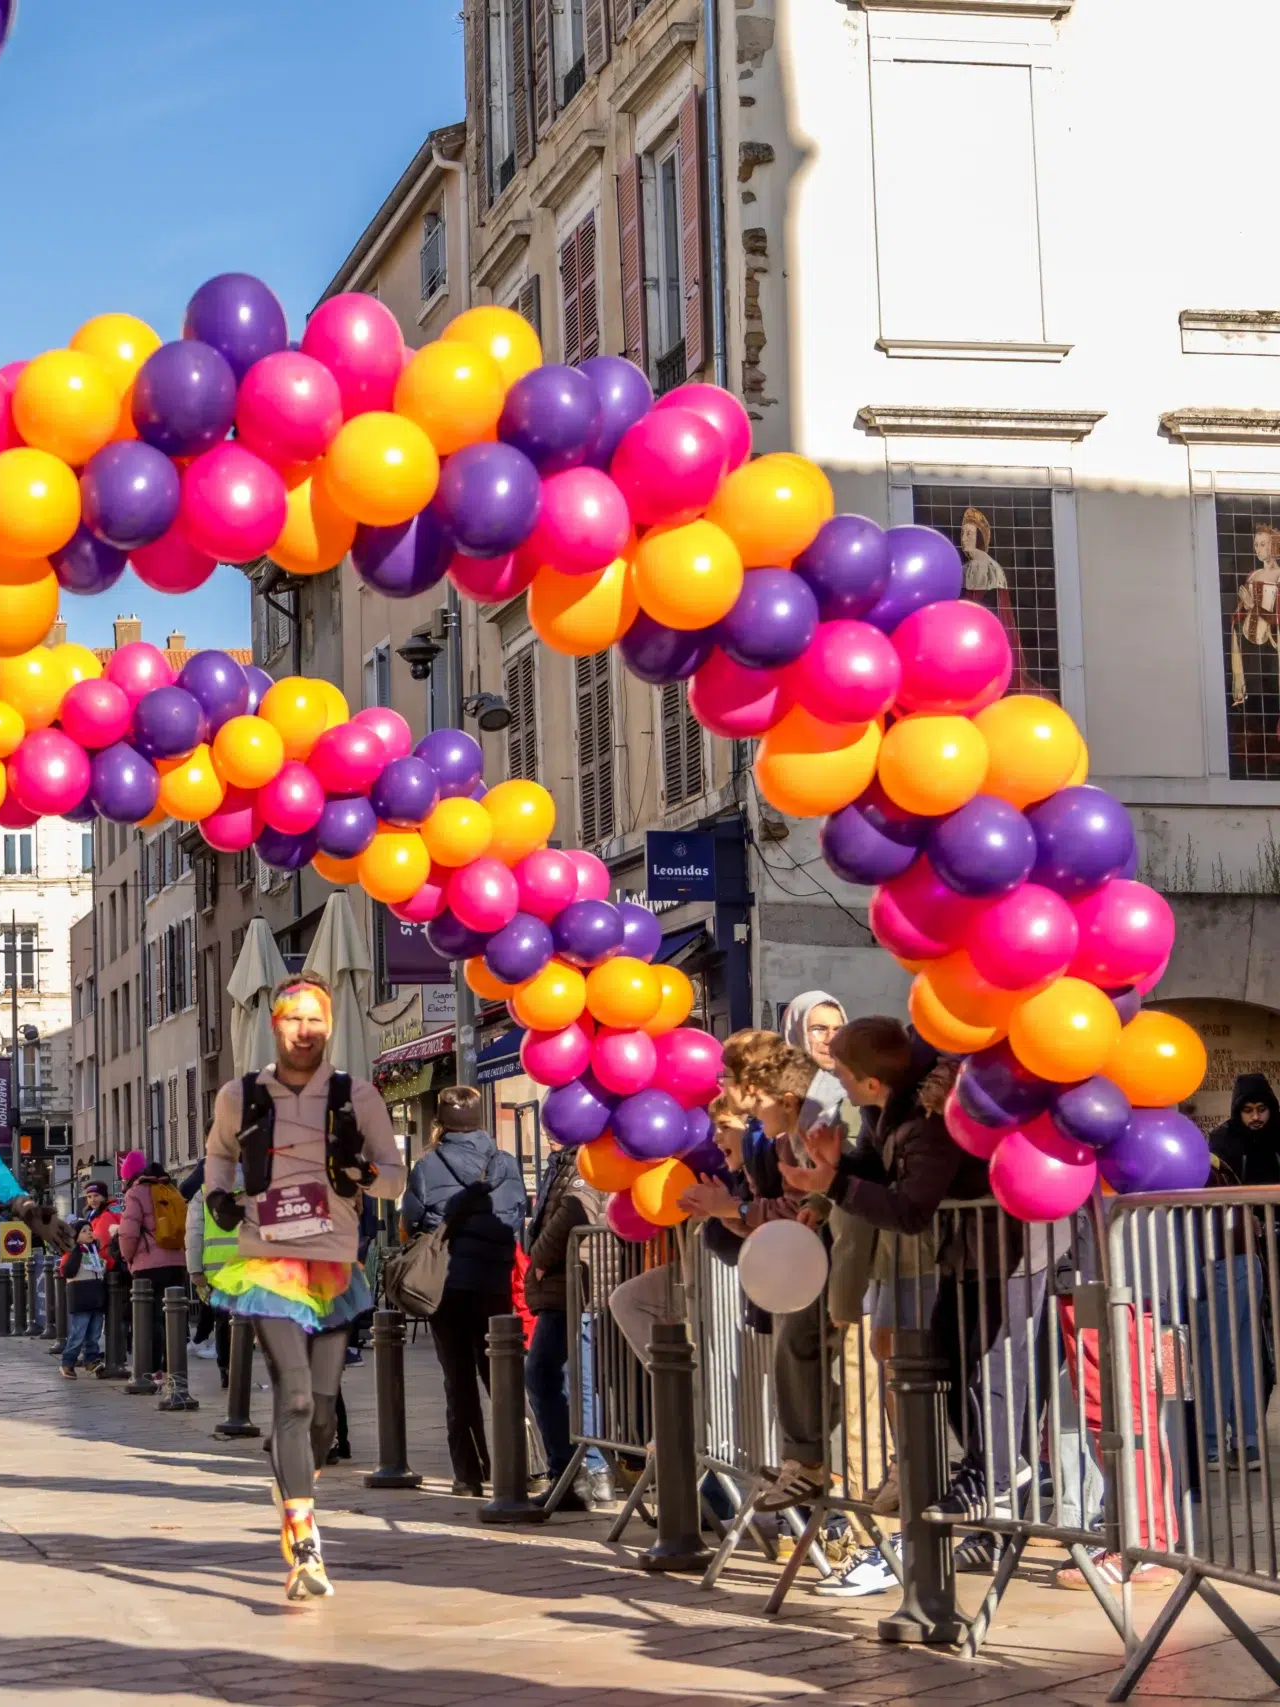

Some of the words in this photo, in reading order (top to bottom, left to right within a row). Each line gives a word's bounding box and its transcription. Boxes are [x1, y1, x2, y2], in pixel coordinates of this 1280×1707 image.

[653, 864, 709, 876] Leonidas
[0, 1077, 8, 1128] MARATHON
[275, 1202, 312, 1218] 2800
